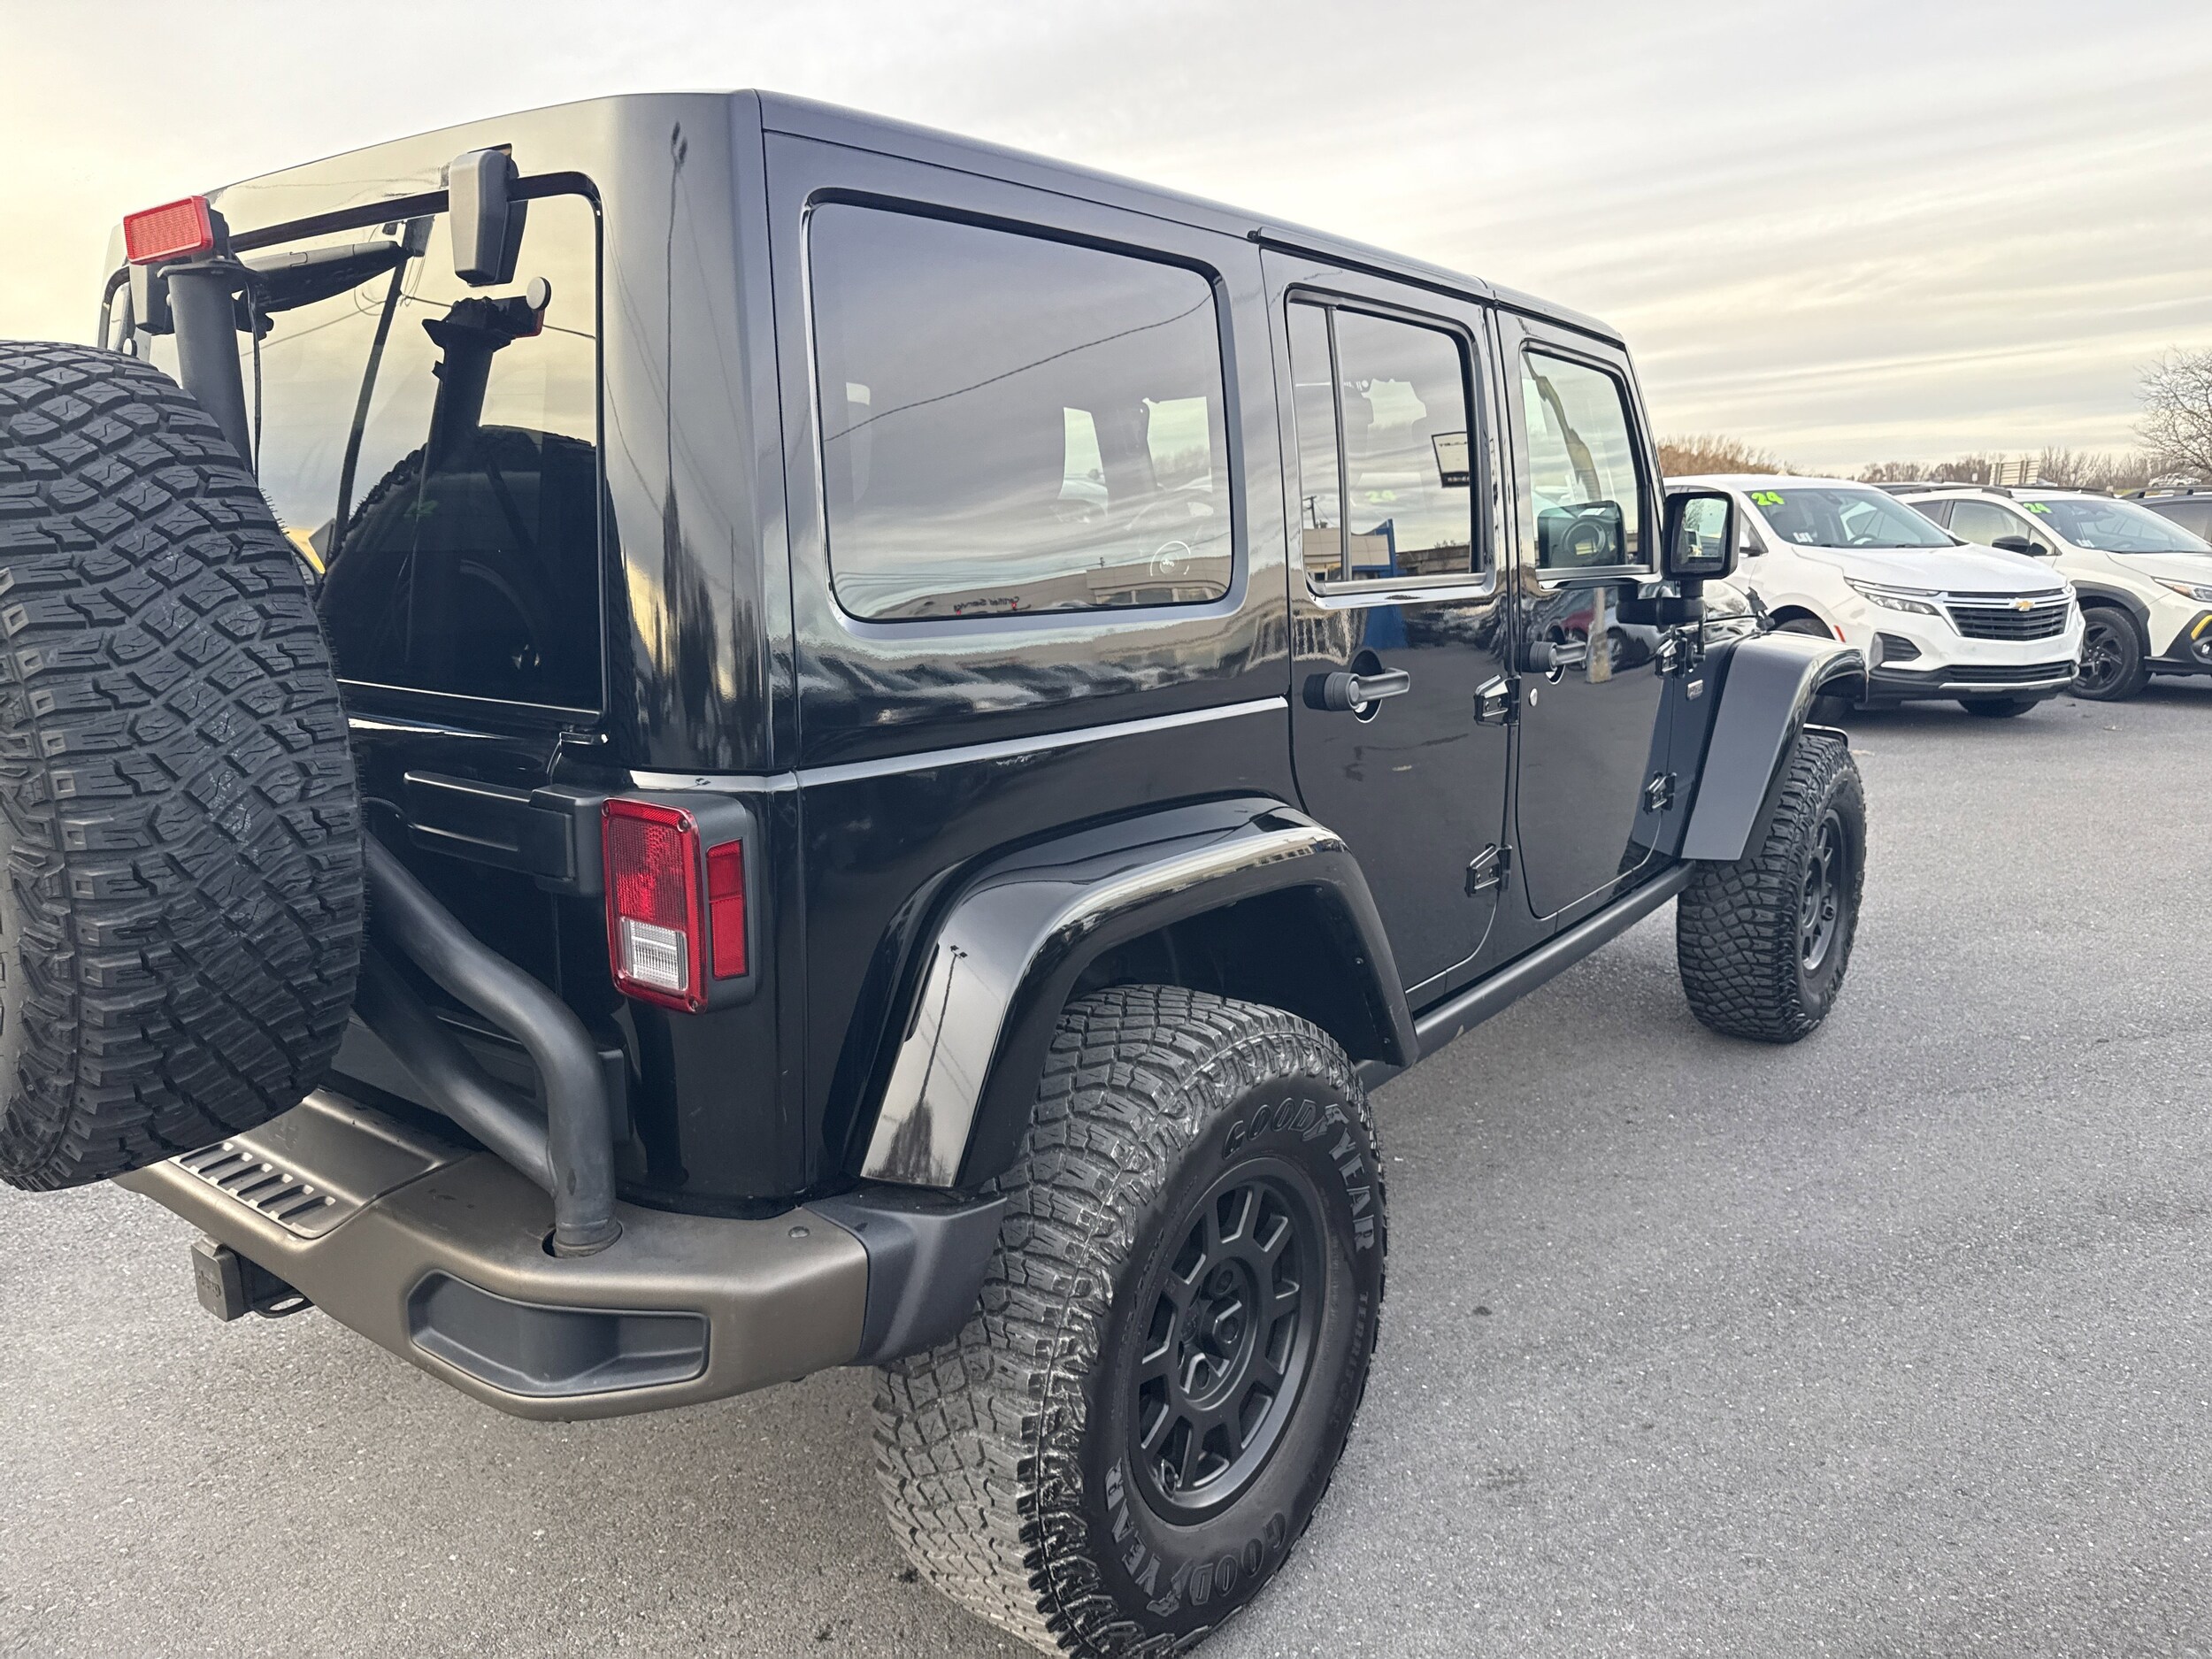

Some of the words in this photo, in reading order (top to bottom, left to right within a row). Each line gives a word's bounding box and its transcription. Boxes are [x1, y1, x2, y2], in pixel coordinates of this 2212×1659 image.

[1751, 491, 1785, 506] 24
[2023, 503, 2053, 514] 24
[1222, 1096, 1376, 1254] GOODYEAR
[1104, 1456, 1286, 1617] GOODYEAR
